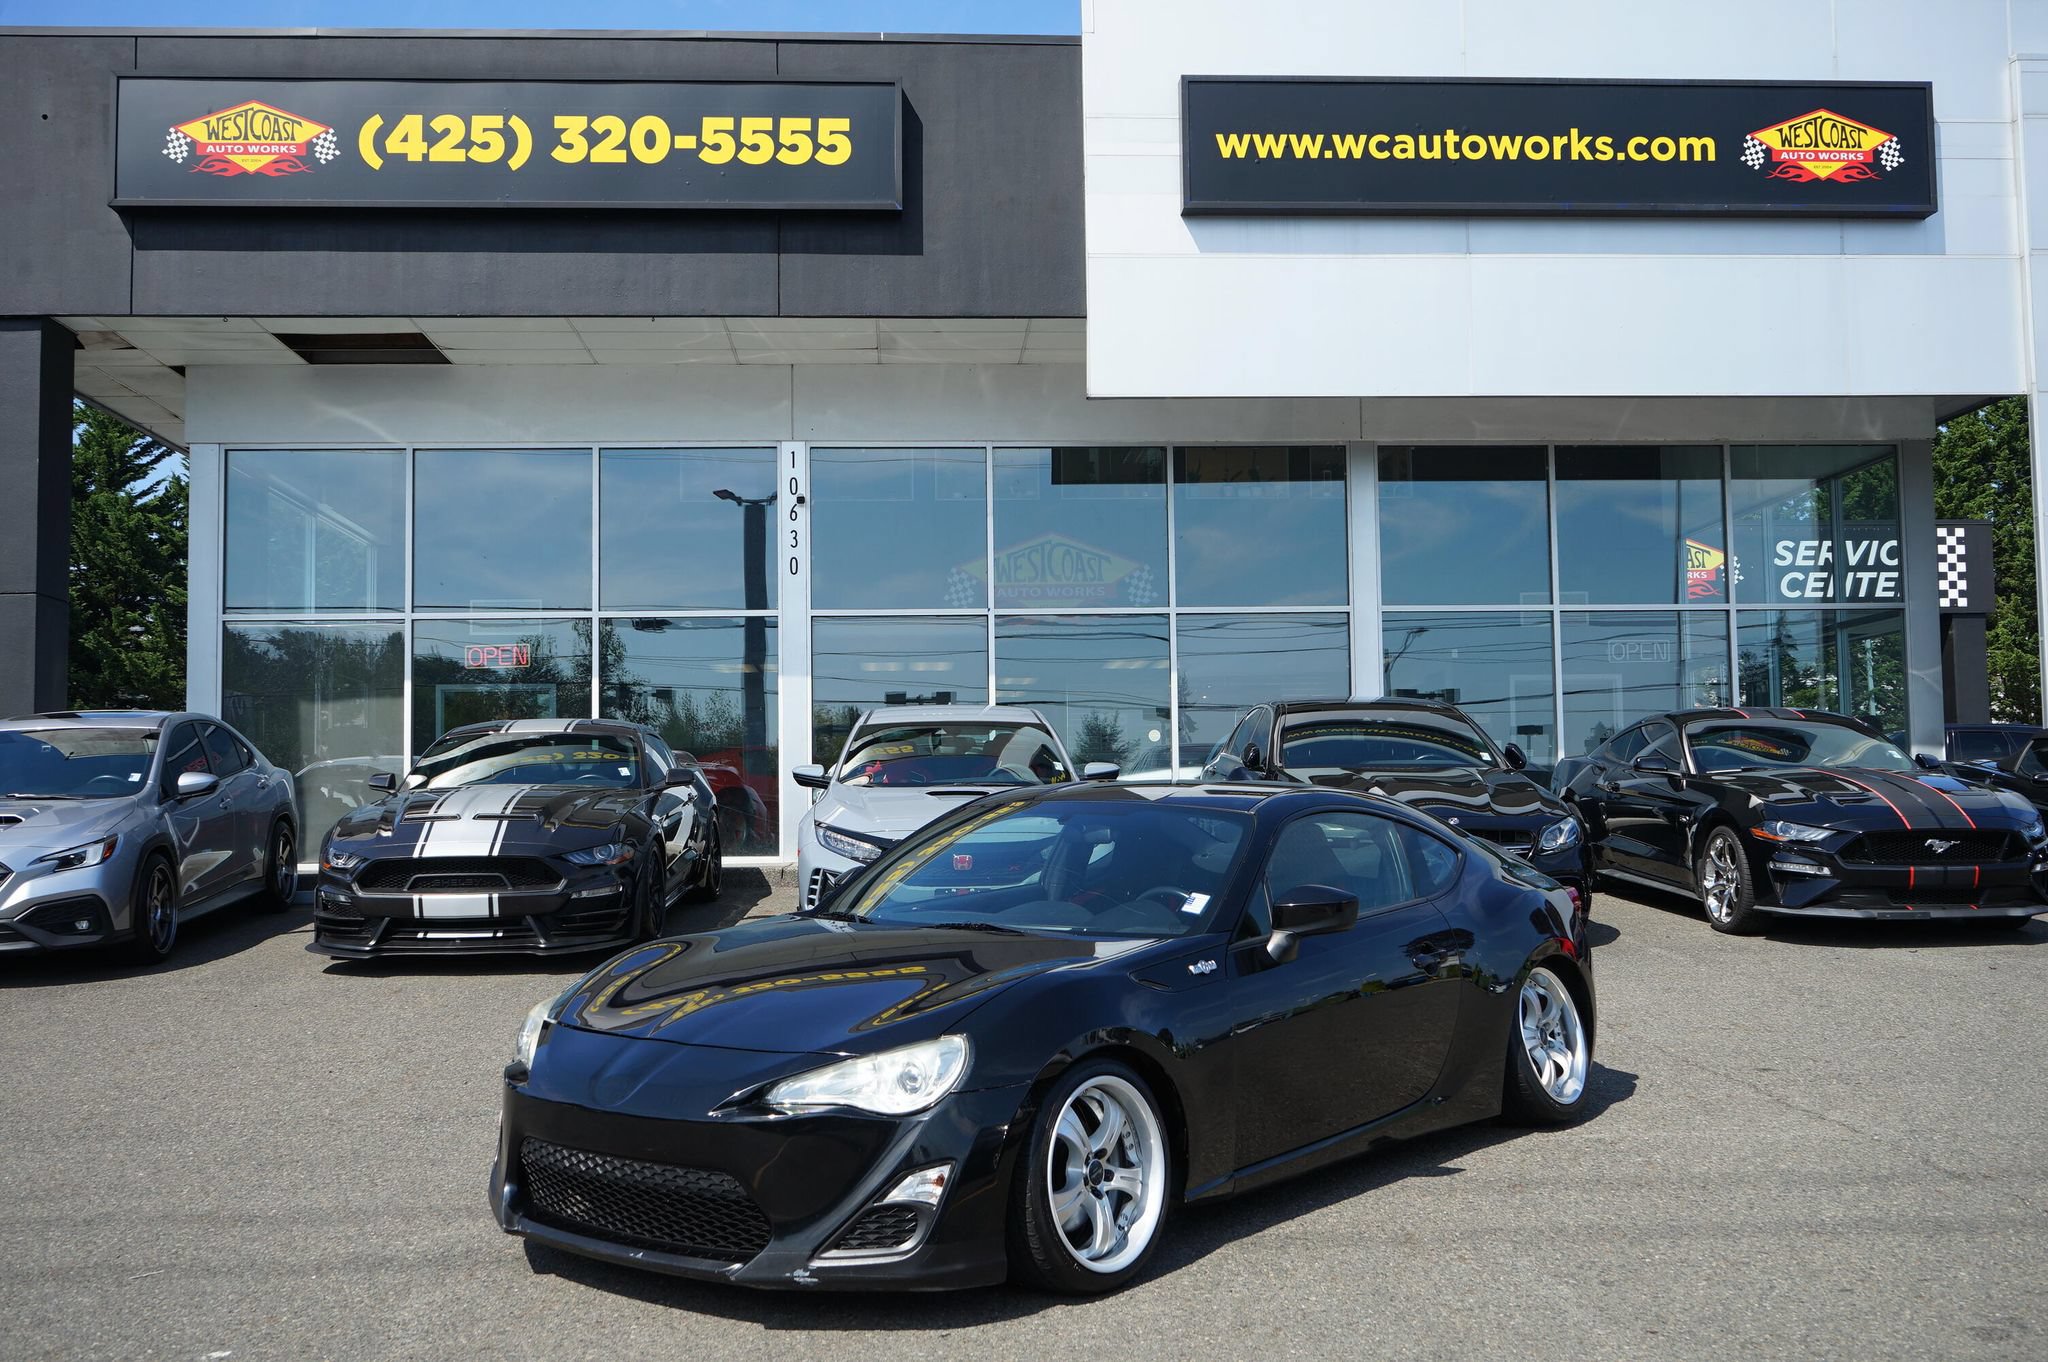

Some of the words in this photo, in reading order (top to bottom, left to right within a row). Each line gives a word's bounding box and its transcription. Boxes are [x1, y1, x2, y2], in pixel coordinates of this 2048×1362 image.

[206, 144, 245, 154] AUTO
[247, 144, 297, 154] WORKS
[358, 113, 533, 171] (425)
[550, 114, 853, 166] 320-5555
[1215, 128, 1717, 162] www.wcautoworks.com
[1780, 151, 1816, 161] AUTO
[1818, 151, 1864, 161] WORKS
[1773, 539, 1899, 567] SERVIC
[1687, 571, 1708, 579] RKS
[997, 586, 1041, 597] AUTO
[1046, 586, 1105, 597] WORKS
[467, 645, 528, 667] OPEN
[1610, 641, 1668, 661] OPEN
